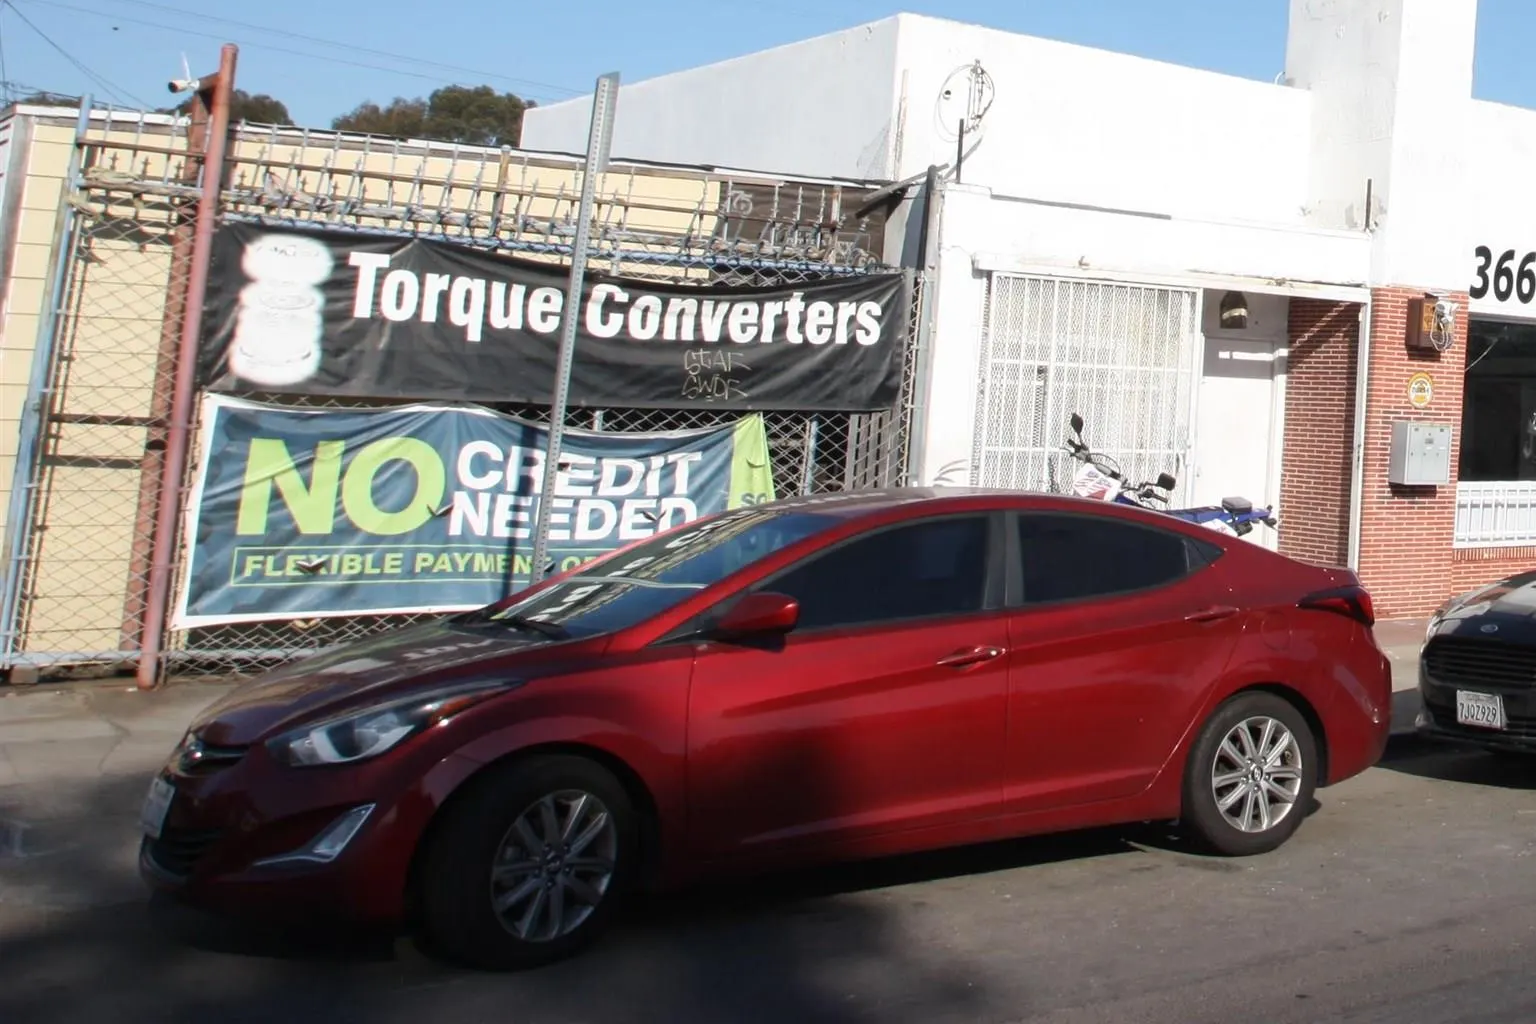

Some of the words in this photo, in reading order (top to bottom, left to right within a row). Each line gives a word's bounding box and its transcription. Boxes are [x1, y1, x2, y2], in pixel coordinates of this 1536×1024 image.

[348, 251, 564, 343] Torque
[585, 283, 883, 346] Converters
[236, 436, 446, 536] NO
[457, 440, 702, 497] CREDIT
[448, 491, 698, 541] NEEDED
[243, 552, 403, 577] FLEXIBLE
